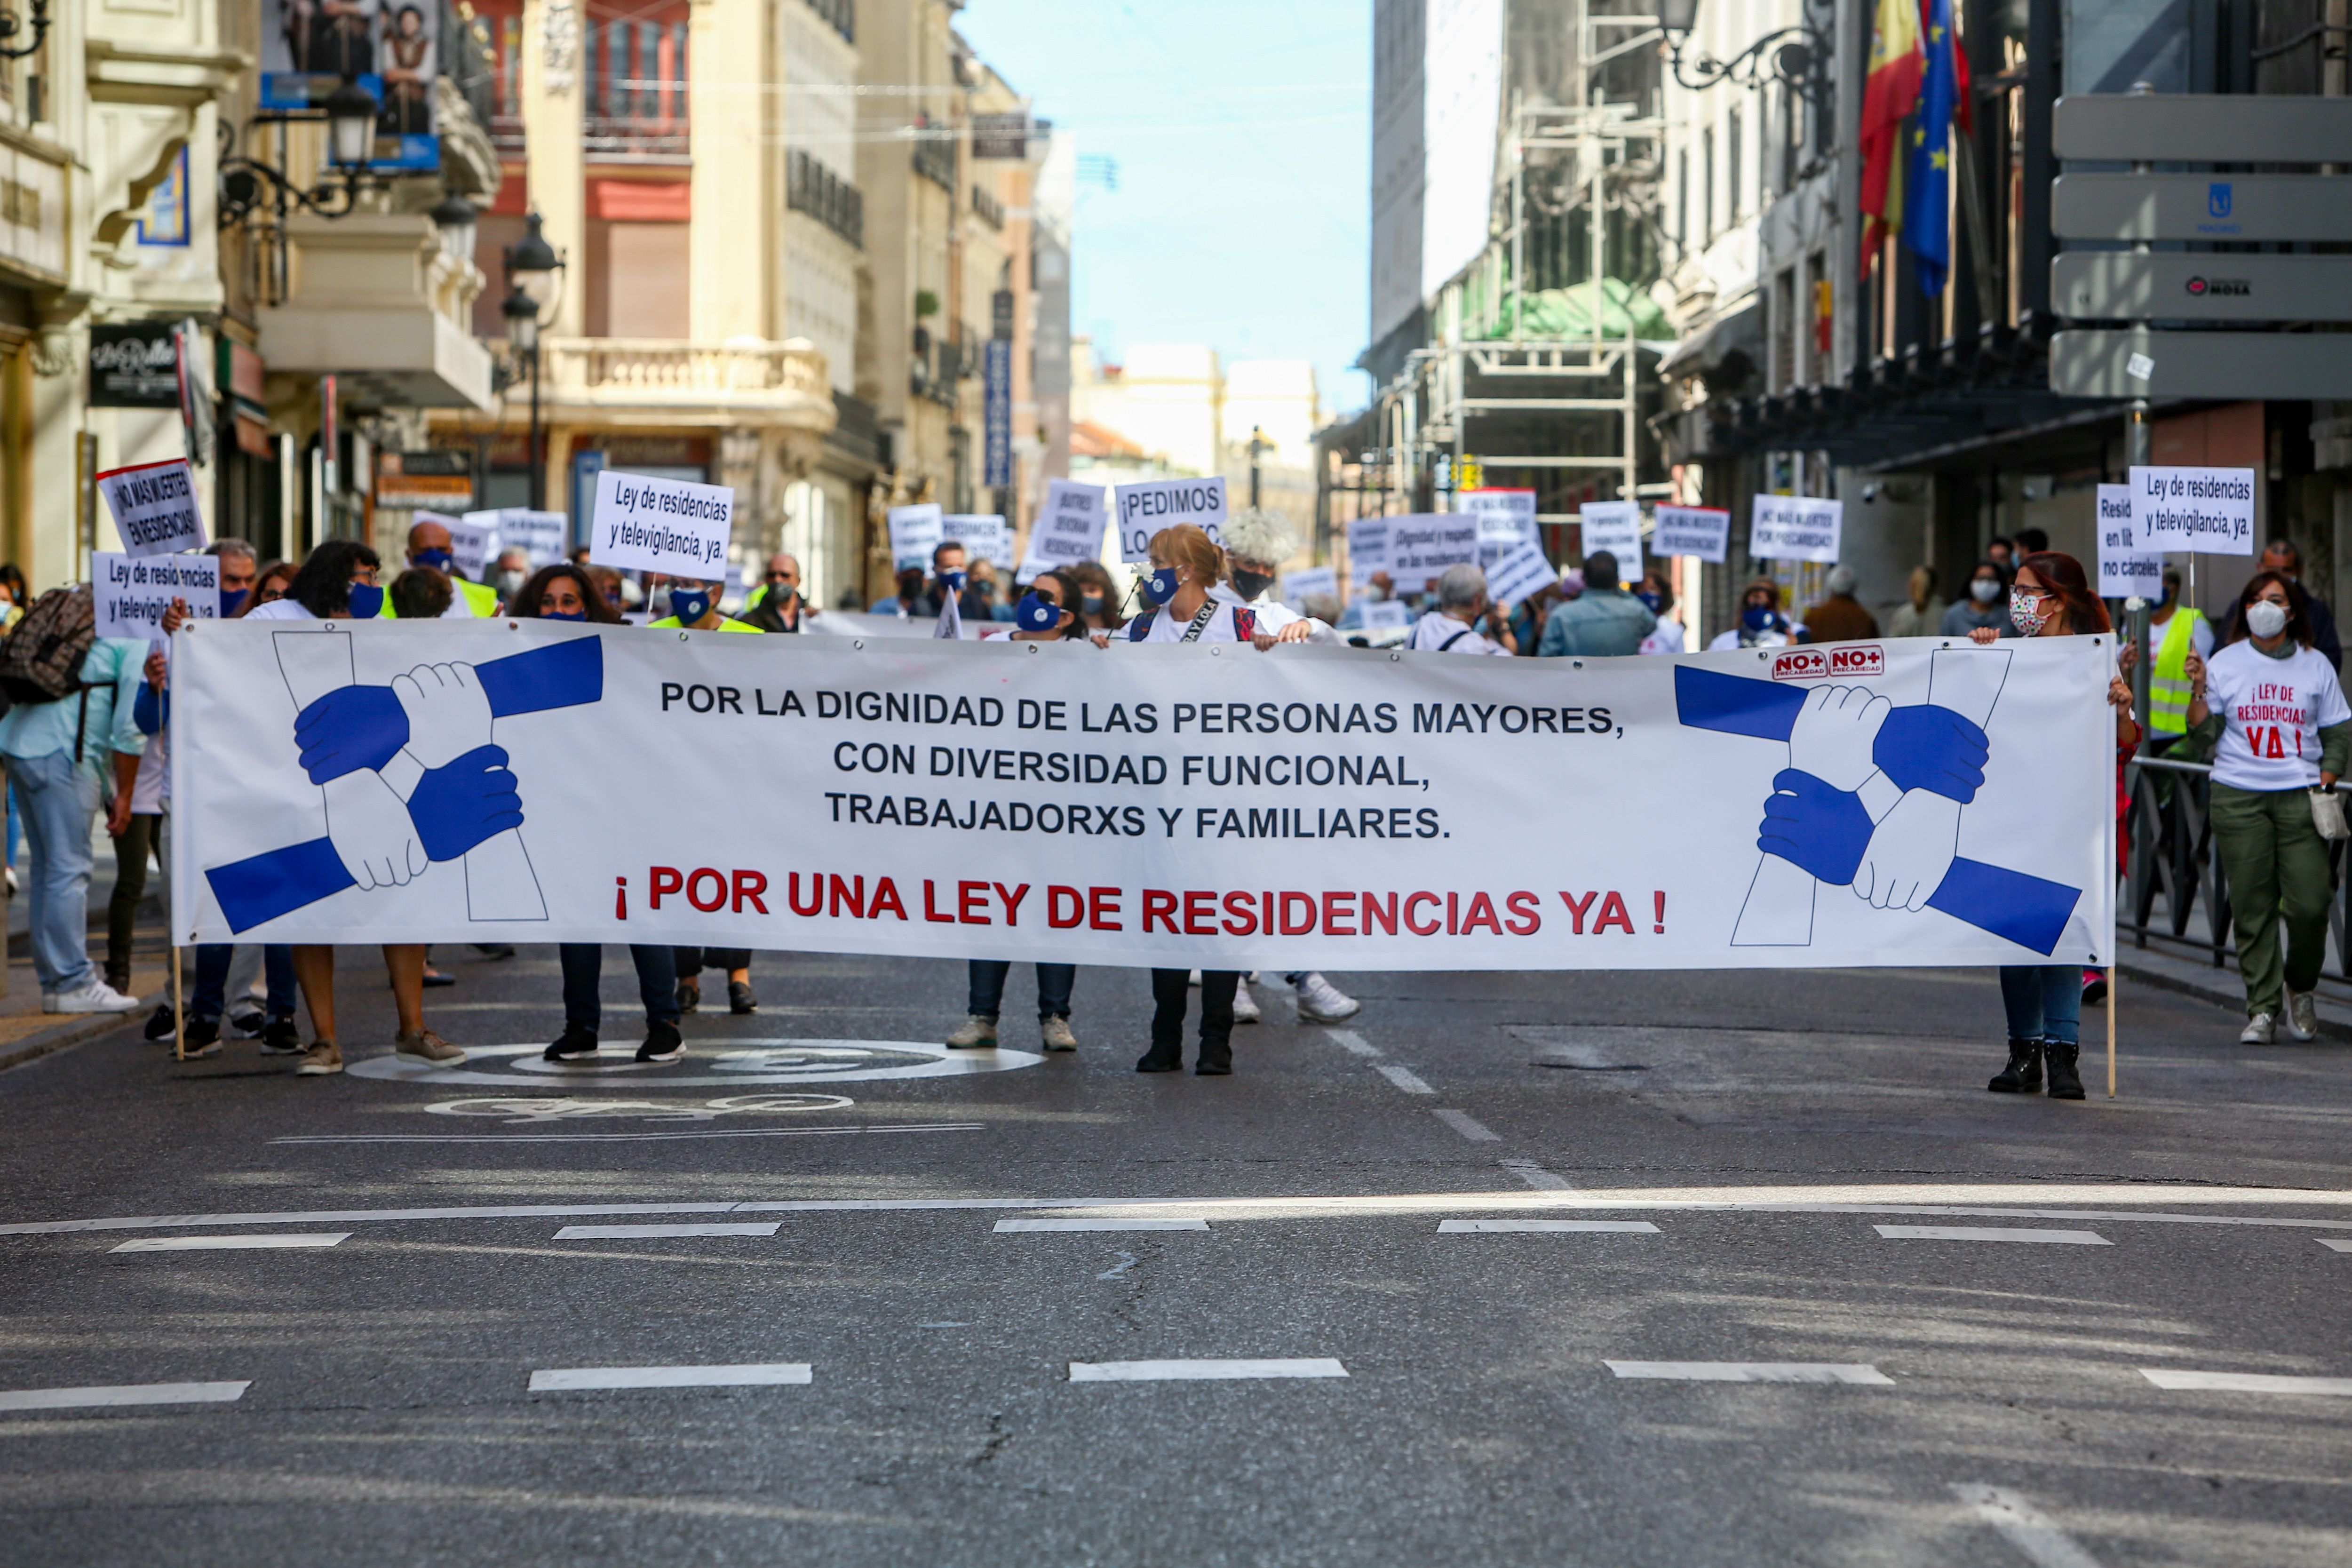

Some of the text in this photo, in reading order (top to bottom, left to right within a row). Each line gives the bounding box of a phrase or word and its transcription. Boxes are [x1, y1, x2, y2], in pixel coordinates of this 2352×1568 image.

[2210, 285, 2250, 295] MOSA
[149, 471, 189, 502] MUERTES
[616, 480, 727, 521] Ley de residencias
[2147, 473, 2250, 501] Ley de residencias
[1122, 486, 1220, 525] ¡PEDIMOS
[2102, 499, 2131, 517] Resid
[127, 522, 145, 546] EN
[2146, 508, 2250, 541] y televigilancia, ya.
[609, 521, 723, 564] y televigilancia, ya.
[1122, 530, 1148, 554] LO
[2106, 532, 2120, 547] en
[110, 558, 215, 589] Ley de residencias
[2104, 561, 2118, 576] no
[110, 599, 116, 622] y
[1776, 655, 1823, 671] NO+
[1833, 651, 1880, 667] NO+
[2259, 684, 2277, 700] LEY
[2280, 685, 2294, 702] DE
[662, 683, 1622, 739] POR LA DIGNIDAD DE LAS PERSONAS MAYORES,
[2238, 705, 2307, 725] RESIDENCIAS
[2246, 726, 2285, 758] YA
[834, 742, 1429, 791] CON DIVERSIDAD FUNCIONAL,
[825, 793, 1450, 838] TRABAJADORXS Y FAMILIARES.
[650, 867, 769, 915] POR
[789, 872, 908, 921] UNA
[924, 879, 1031, 927] LEY
[1048, 885, 1123, 931] DE
[1143, 889, 1541, 936] RESIDENCIAS
[1559, 891, 1635, 935] YA
